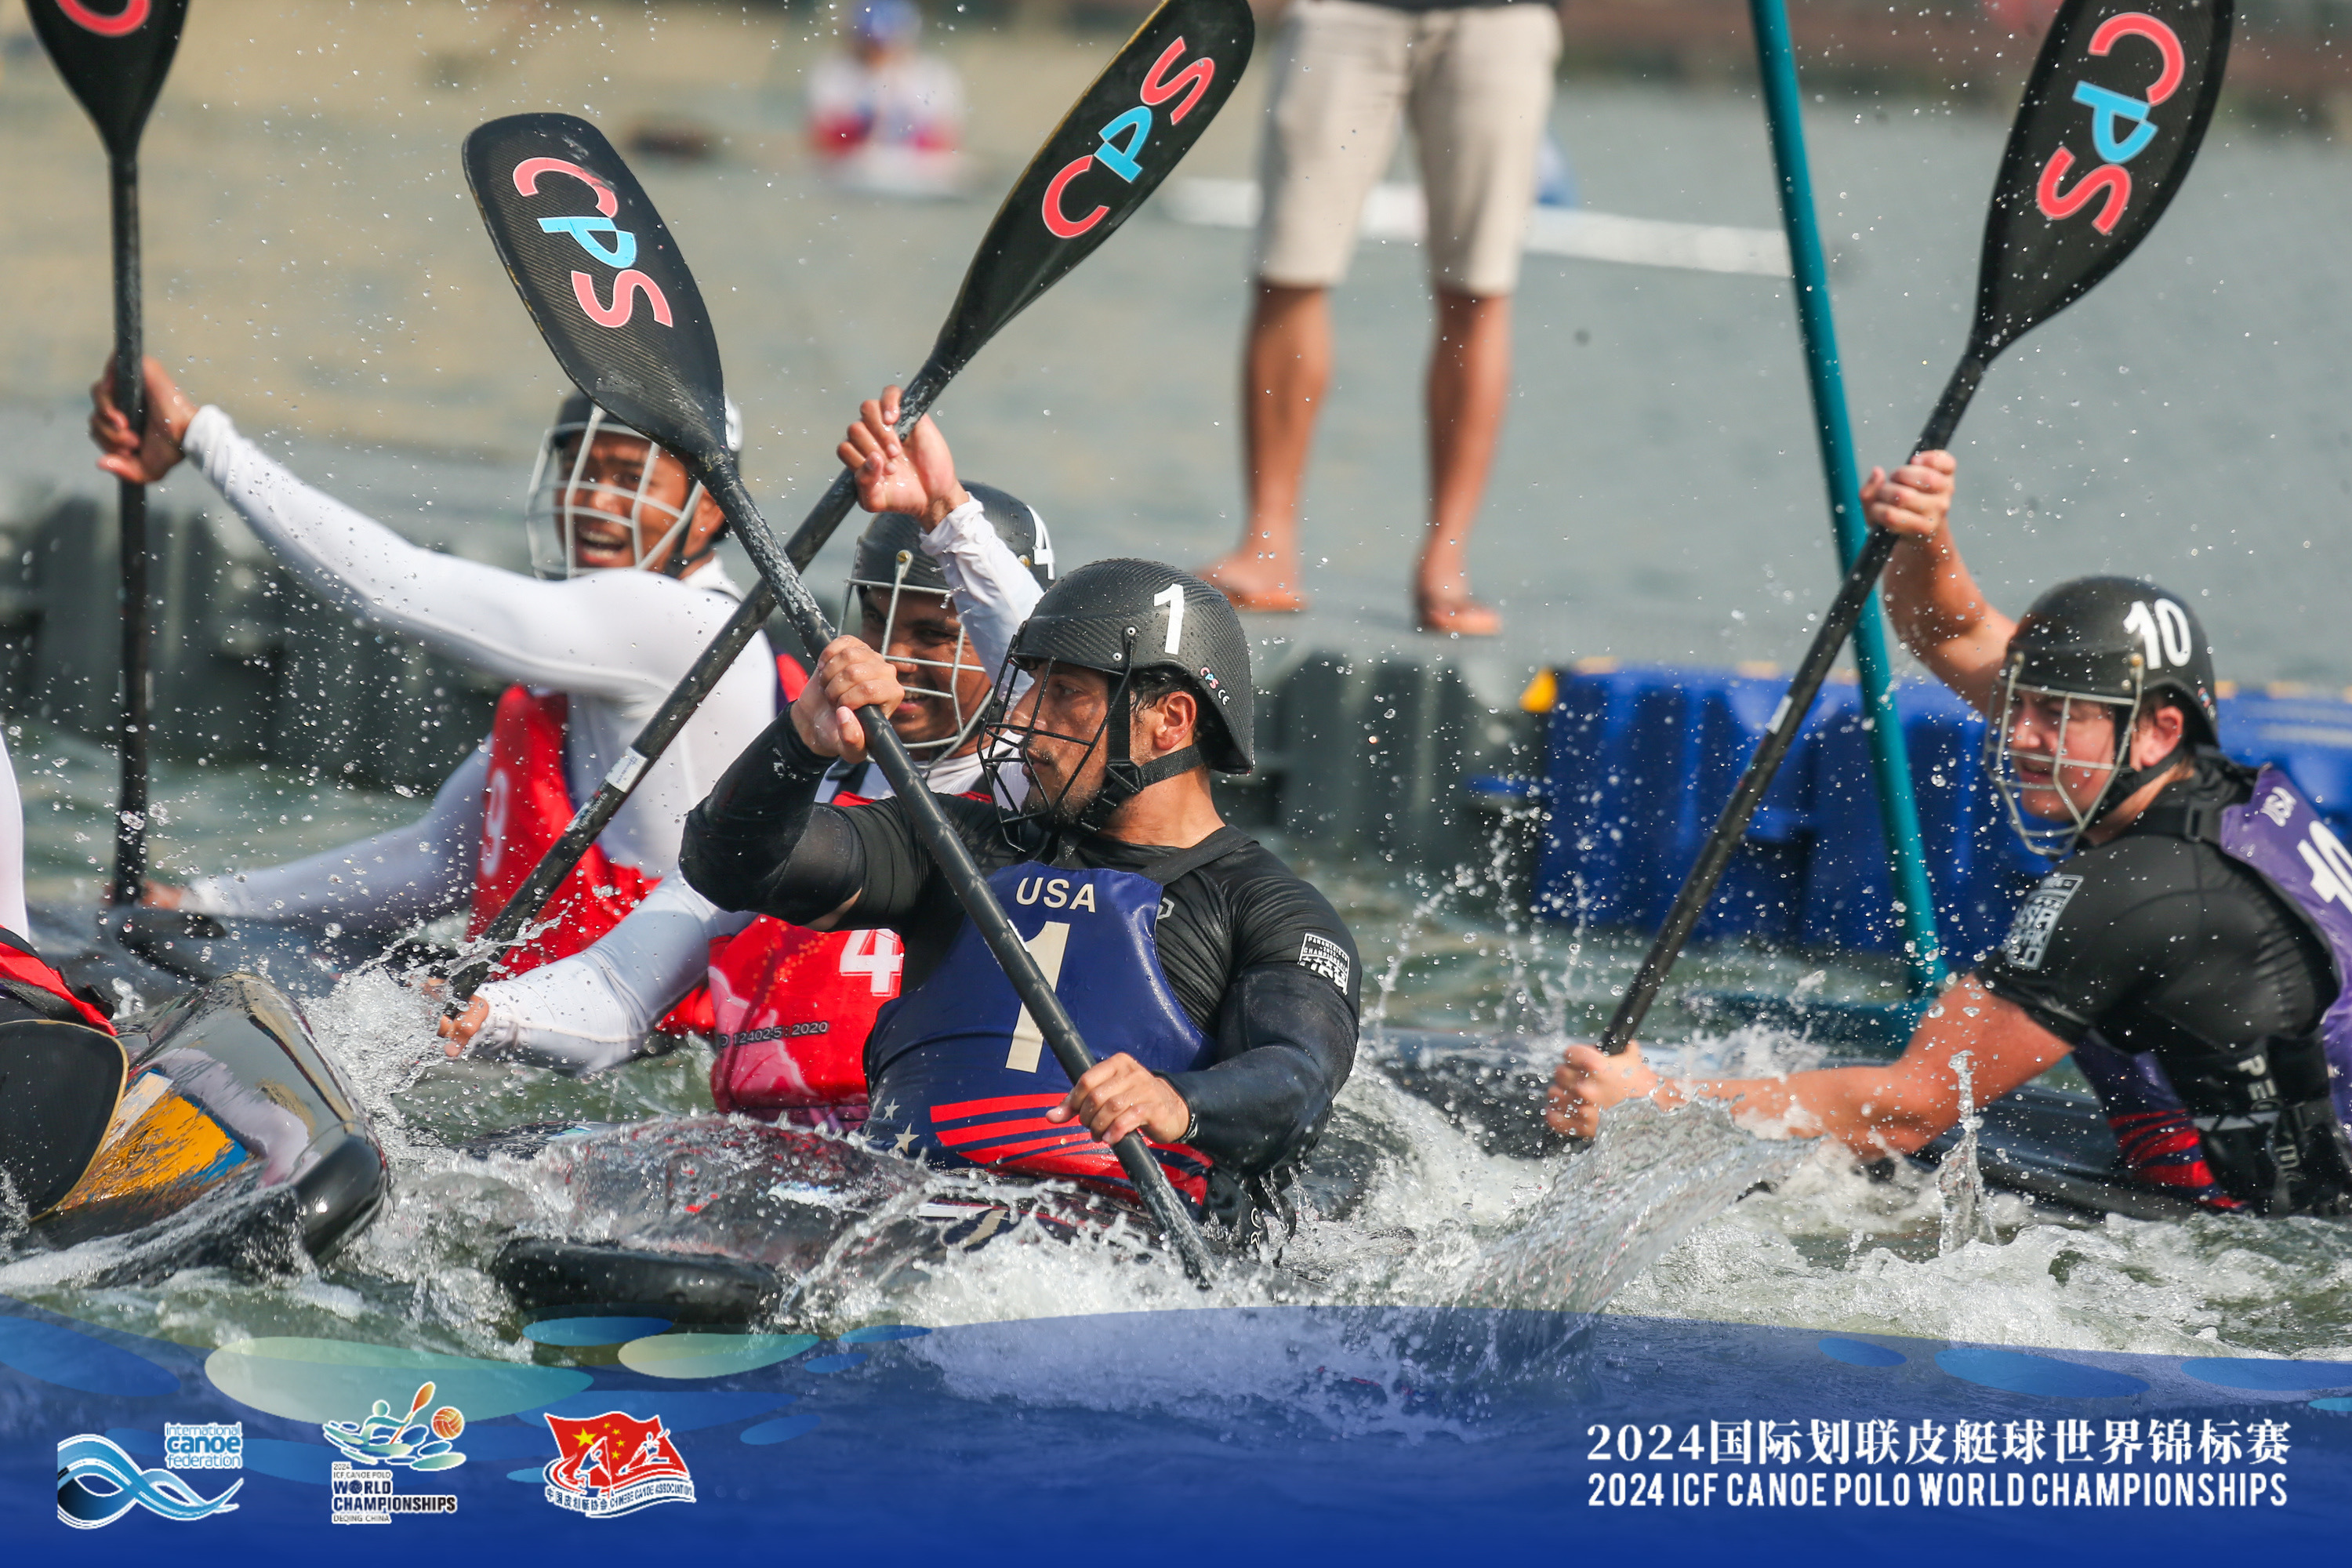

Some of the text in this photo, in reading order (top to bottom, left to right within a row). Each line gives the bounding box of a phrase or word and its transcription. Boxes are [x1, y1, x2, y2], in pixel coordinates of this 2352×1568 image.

[1042, 36, 1214, 238] CPS
[2036, 12, 2185, 234] CPS
[513, 157, 673, 328] CPS
[1154, 583, 1185, 655] 1
[2122, 597, 2192, 670] 10
[1200, 666, 1219, 689] CPS
[481, 769, 509, 878] 9
[1016, 877, 1096, 913] USA
[839, 928, 902, 997] 4
[1004, 920, 1071, 1073] 1
